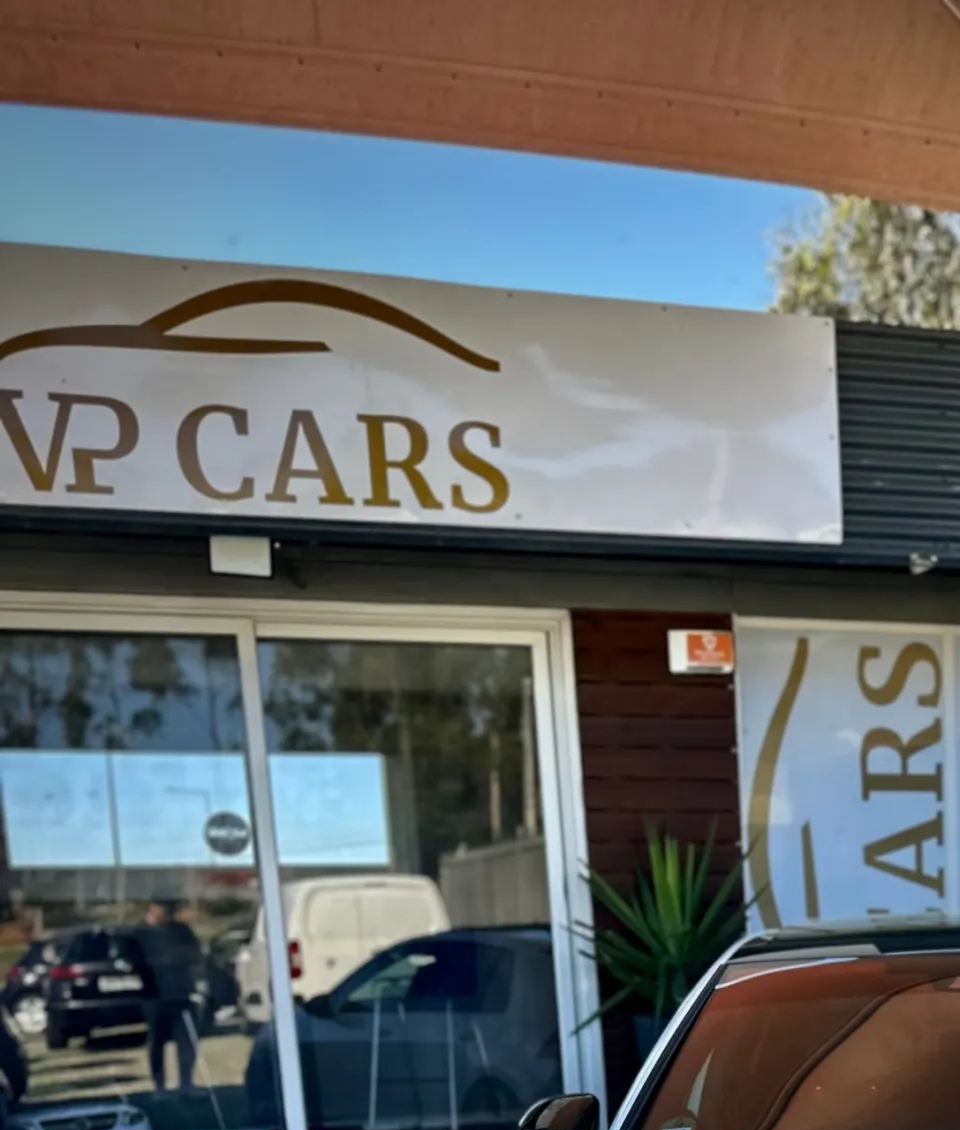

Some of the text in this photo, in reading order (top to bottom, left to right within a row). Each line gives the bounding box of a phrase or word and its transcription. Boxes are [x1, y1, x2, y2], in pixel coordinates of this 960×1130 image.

[0, 389, 510, 513] VP CARS
[857, 641, 944, 914] ARS
